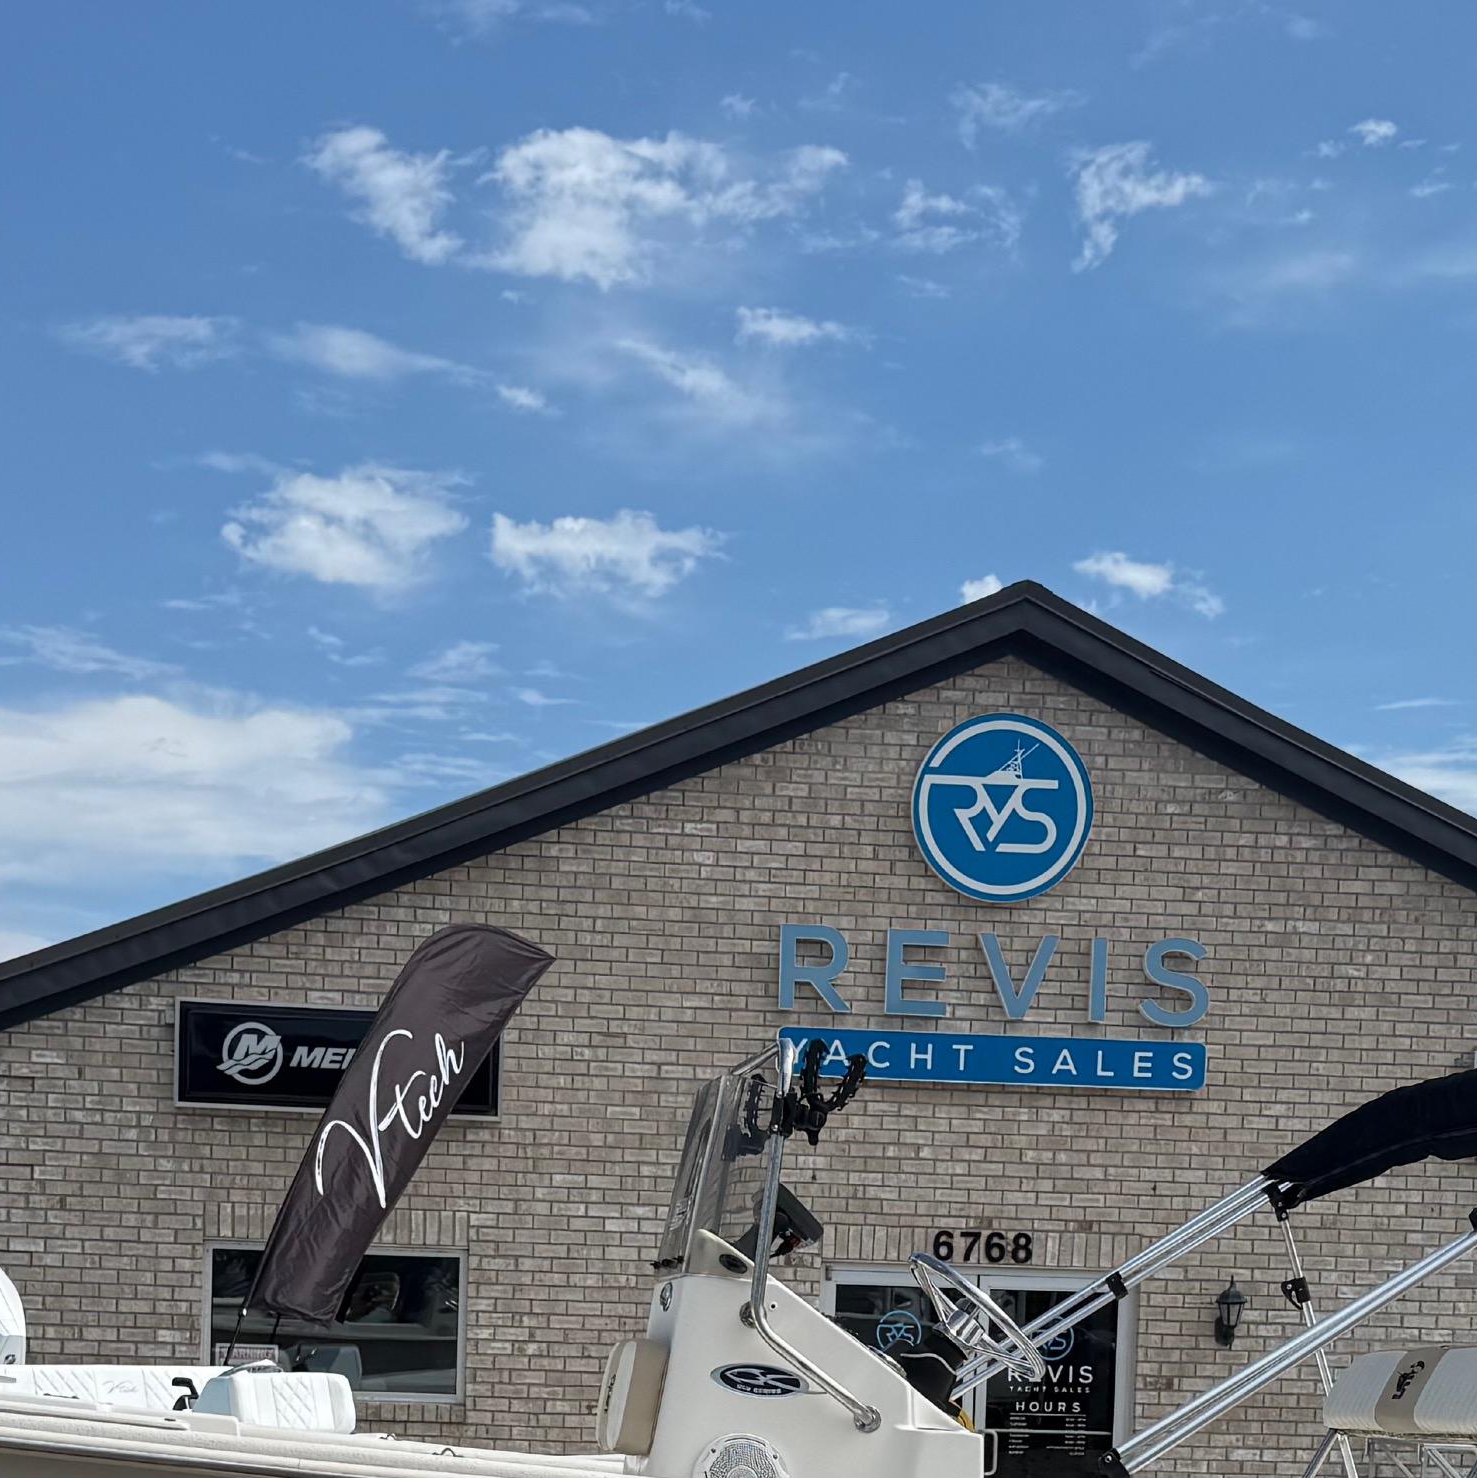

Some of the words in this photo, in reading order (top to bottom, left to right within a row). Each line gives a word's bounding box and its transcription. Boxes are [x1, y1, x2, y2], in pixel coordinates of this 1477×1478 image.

[777, 923, 1211, 1027] REVIS
[1013, 1046, 1194, 1080] SALES
[933, 1230, 1033, 1264] 6768
[1015, 1401, 1082, 1413] HOURS
[1053, 1386, 1091, 1394] SALES
